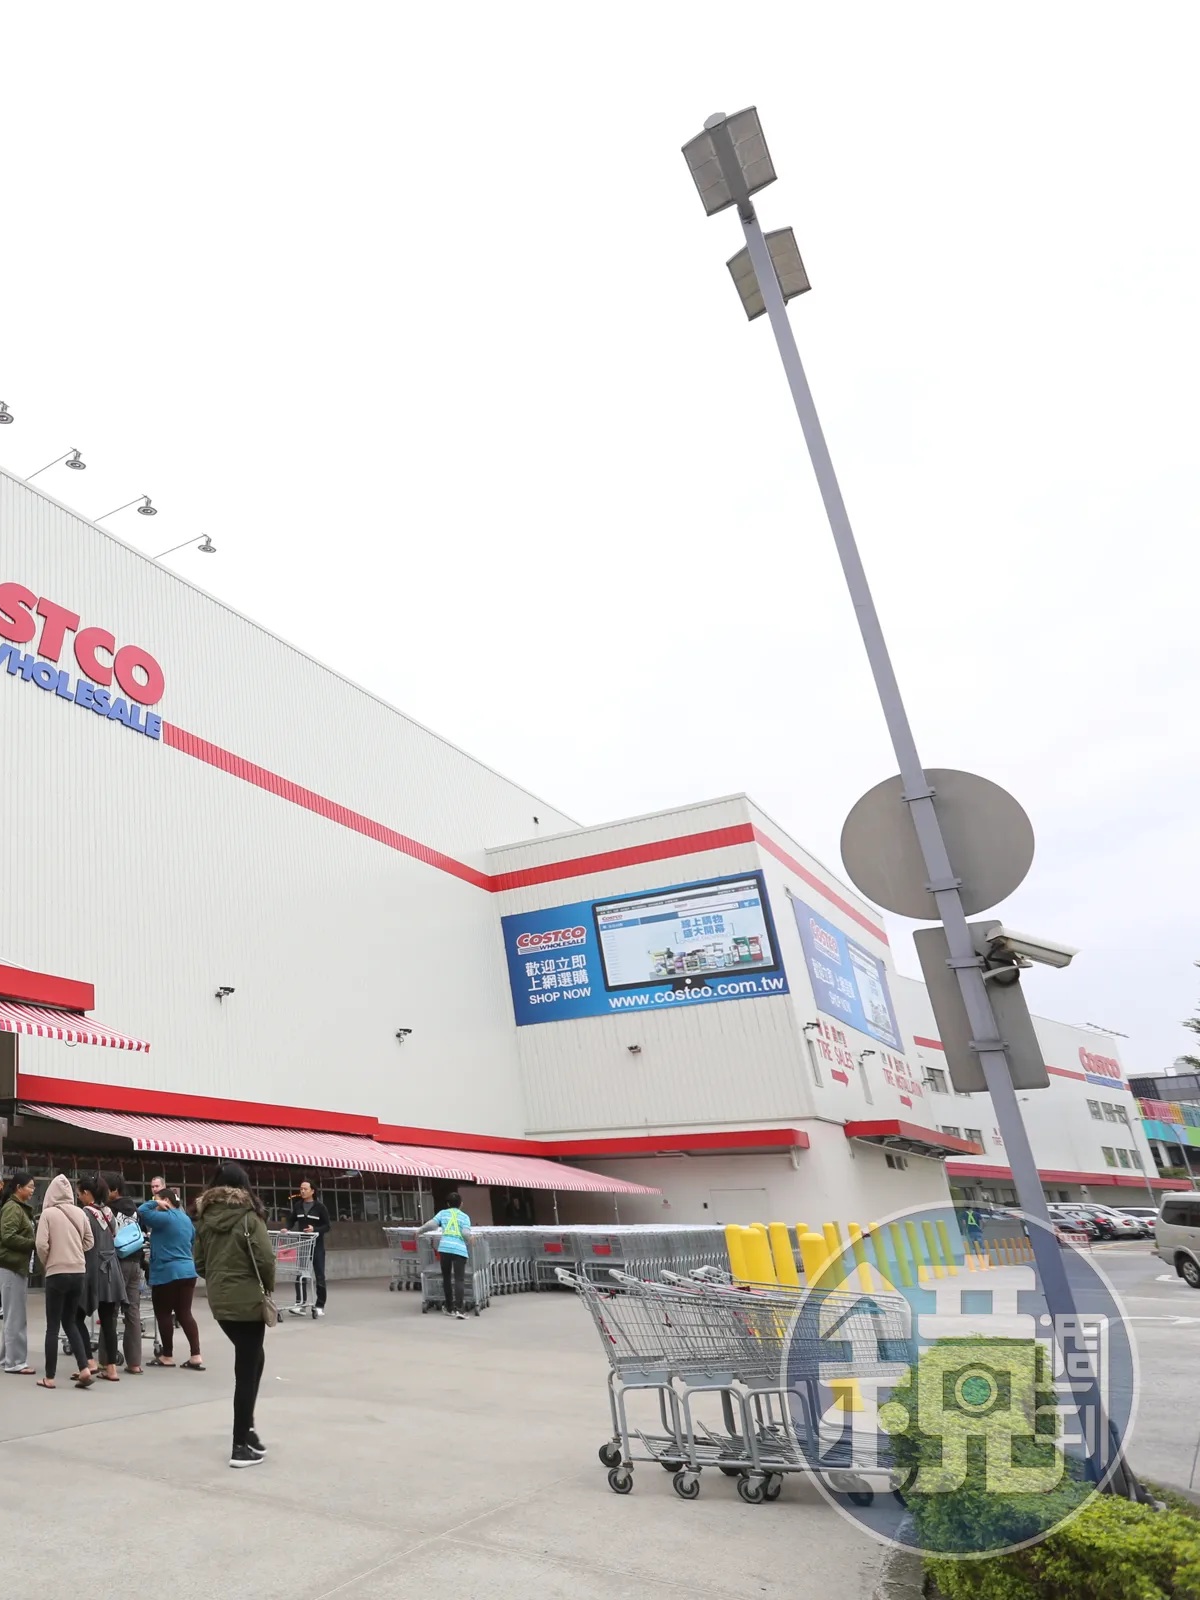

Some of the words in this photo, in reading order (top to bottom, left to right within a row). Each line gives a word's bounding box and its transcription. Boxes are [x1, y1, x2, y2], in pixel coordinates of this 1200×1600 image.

[517, 926, 586, 948] COSTCO
[539, 937, 586, 951] WHOLESALE
[525, 953, 587, 977] 歡迎立即
[528, 972, 589, 992] 上網選購
[609, 976, 784, 1009] www.costco.com.tw
[529, 993, 561, 1005] SHOP
[563, 986, 591, 1001] NOW
[834, 1046, 855, 1071] SALES
[1078, 1046, 1121, 1079] COSTCO
